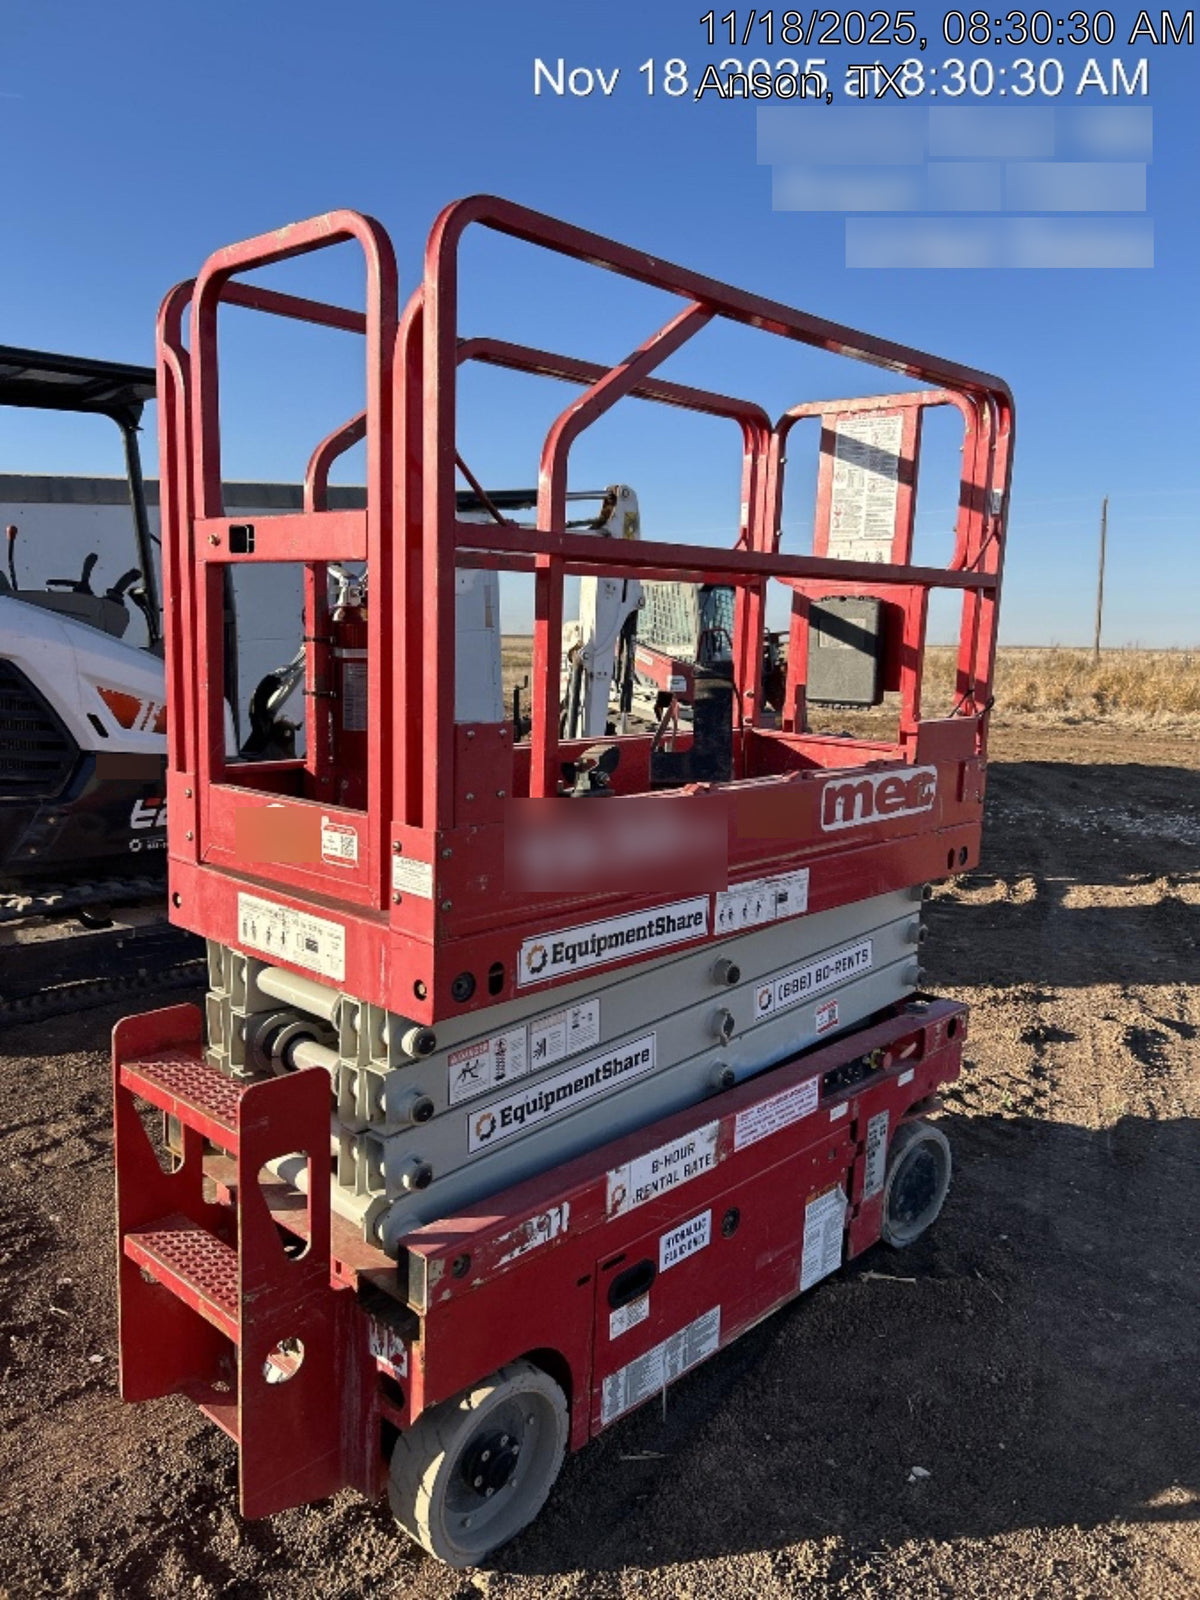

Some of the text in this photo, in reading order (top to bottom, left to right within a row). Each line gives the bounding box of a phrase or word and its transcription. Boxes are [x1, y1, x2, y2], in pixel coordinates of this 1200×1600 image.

[551, 911, 703, 965] EquipmentShare
[500, 1047, 650, 1128] EquipmentShare
[636, 1153, 712, 1202] RENTAL RATE
